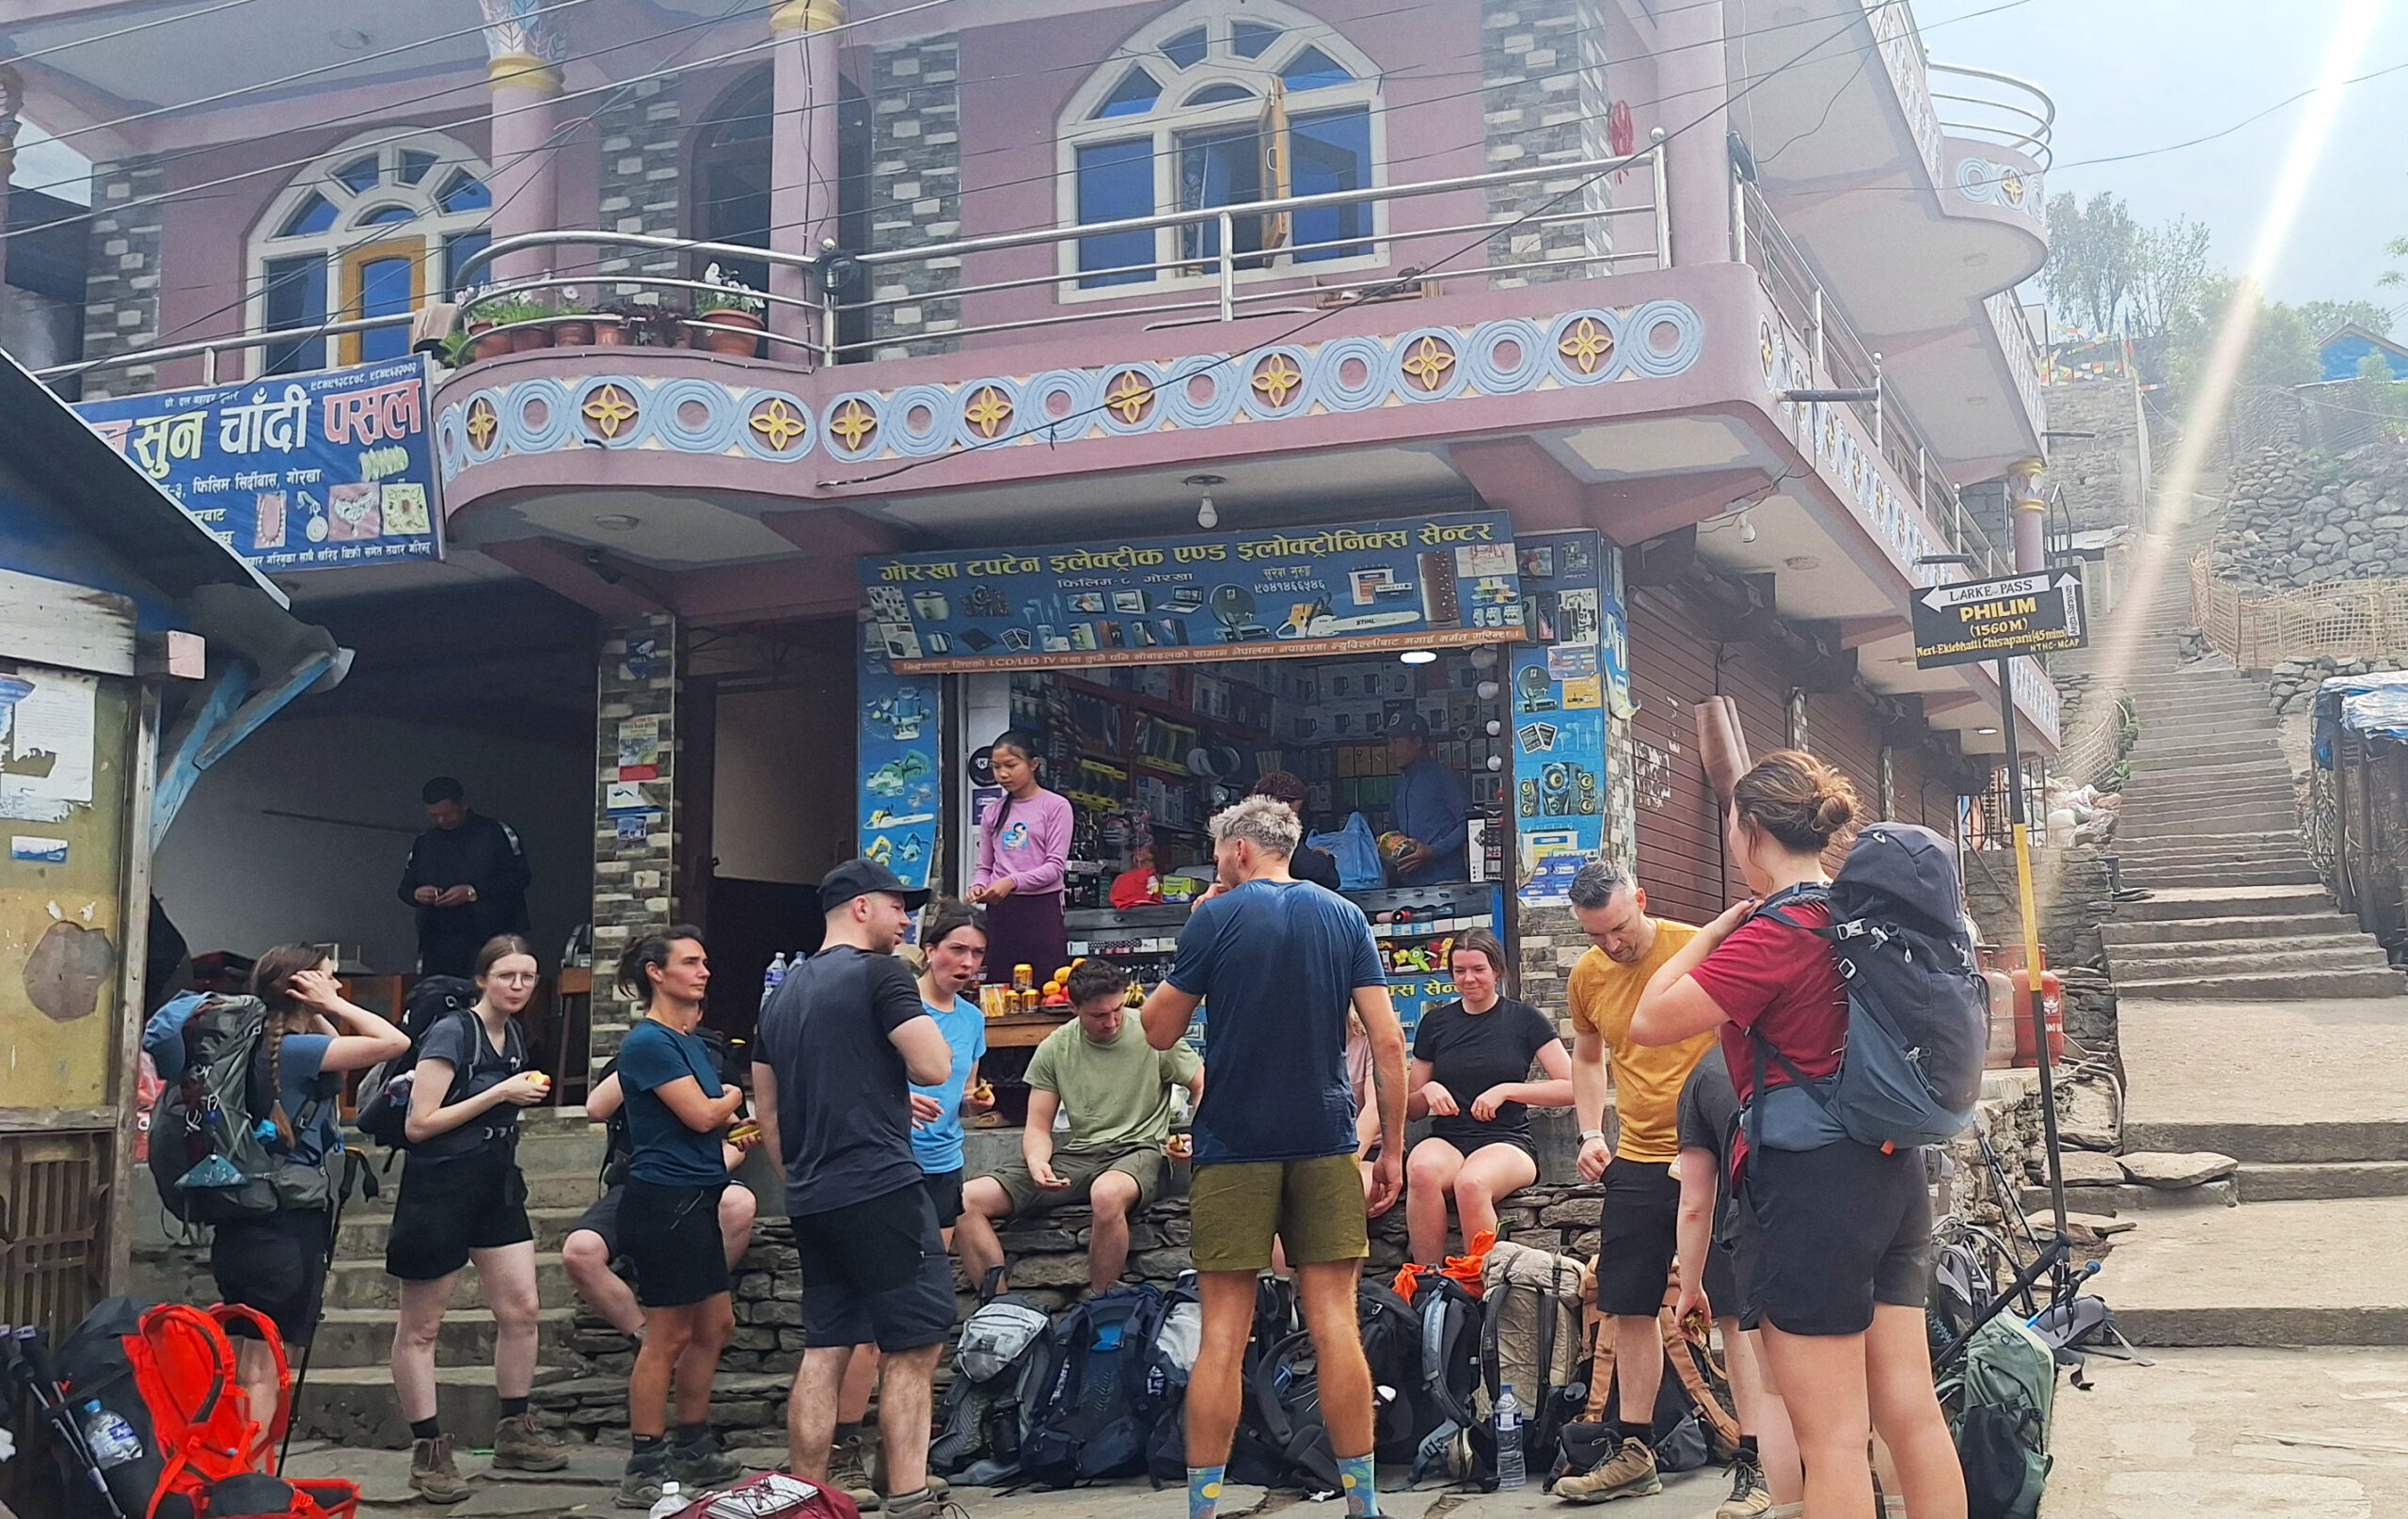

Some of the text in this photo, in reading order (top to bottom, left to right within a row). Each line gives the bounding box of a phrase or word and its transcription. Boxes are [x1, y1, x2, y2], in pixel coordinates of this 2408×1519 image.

[134, 411, 208, 479] सुन
[219, 384, 312, 453] चाँदी
[323, 378, 422, 446] पसल
[193, 474, 231, 494] फिलिम
[286, 467, 322, 485] गोरखा
[879, 560, 959, 581] गोरखा
[1172, 544, 1228, 563] एण्ड
[1418, 522, 1495, 546] सेन्टर
[1143, 573, 1194, 583] गोरखा
[2000, 579, 2033, 595] PASS
[1959, 596, 2037, 623] PHILIM
[1356, 618, 1376, 626] STIHL
[990, 657, 1039, 668] LCD/LED
[1043, 656, 1056, 665] TV
